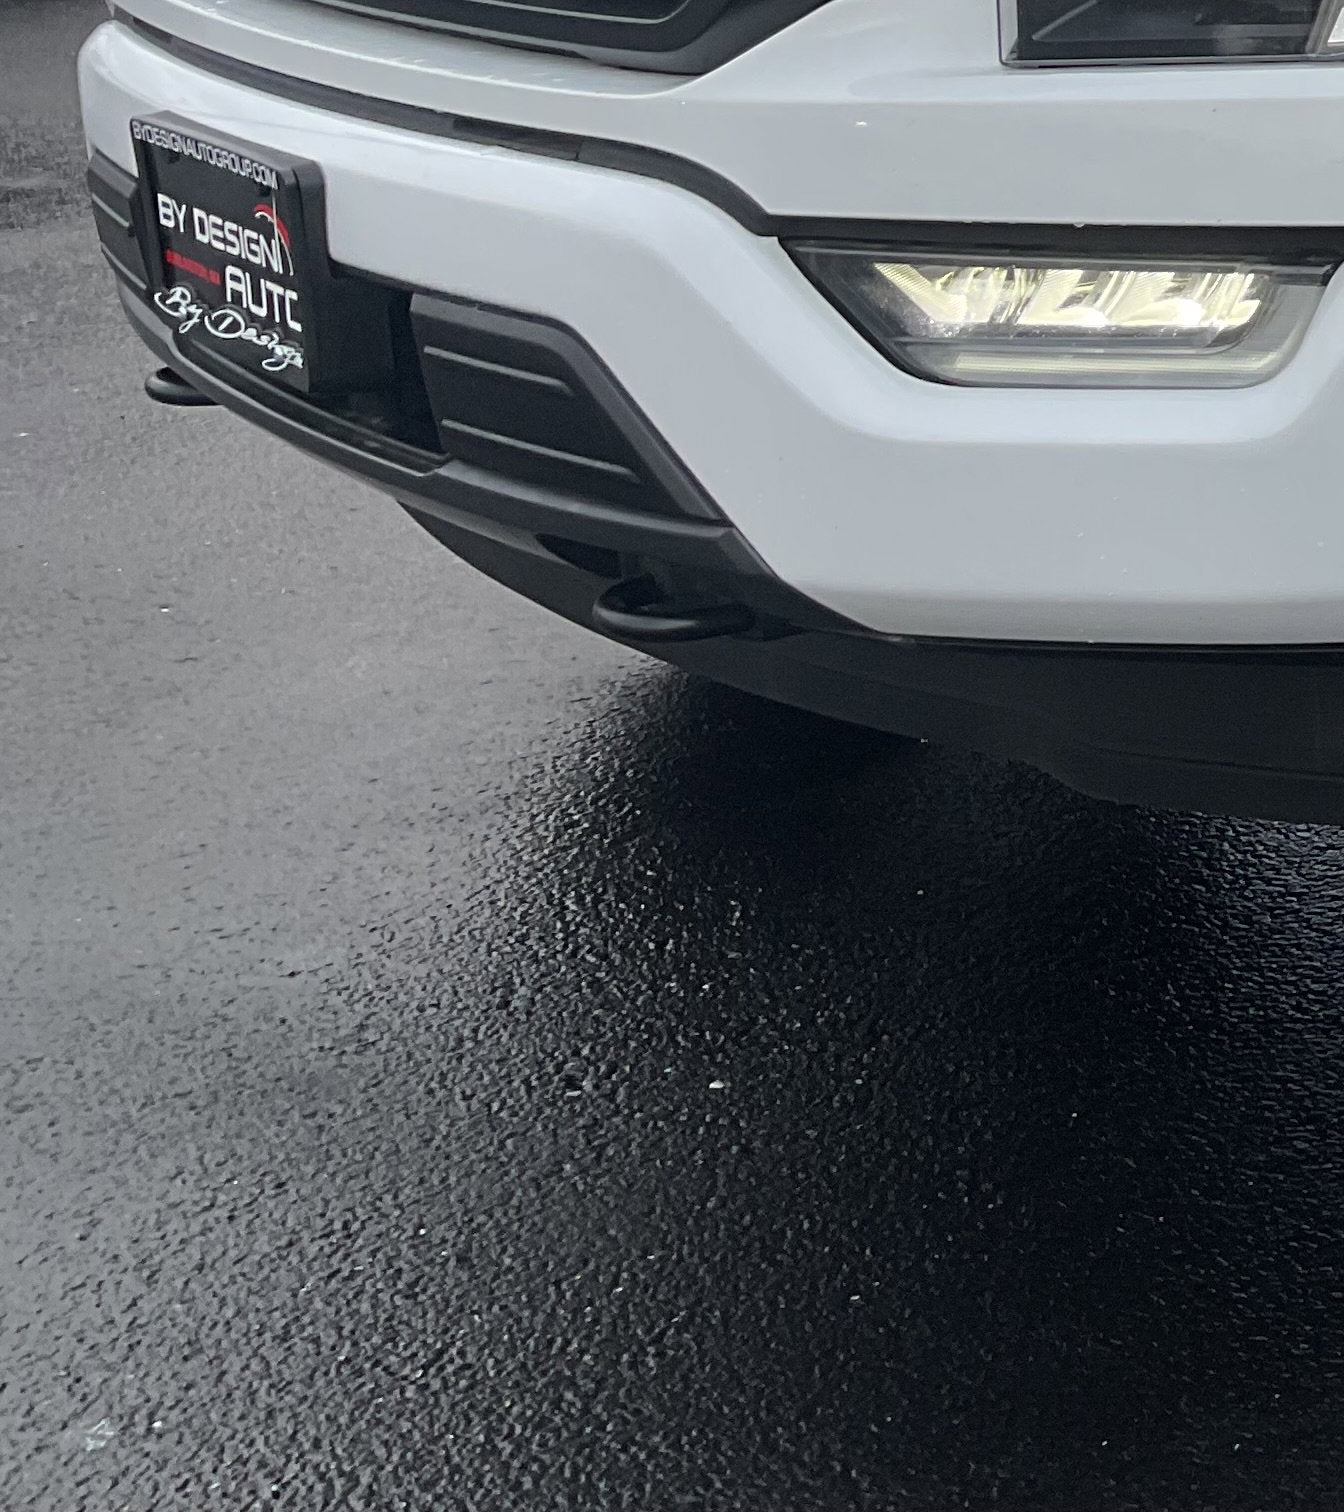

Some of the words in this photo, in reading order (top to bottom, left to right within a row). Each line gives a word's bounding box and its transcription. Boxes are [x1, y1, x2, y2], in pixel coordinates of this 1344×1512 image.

[132, 120, 280, 190] BYDESIGNAUTOGROUP.COM
[157, 193, 186, 233] BY
[192, 207, 280, 274] DESIGN
[154, 287, 203, 334] By
